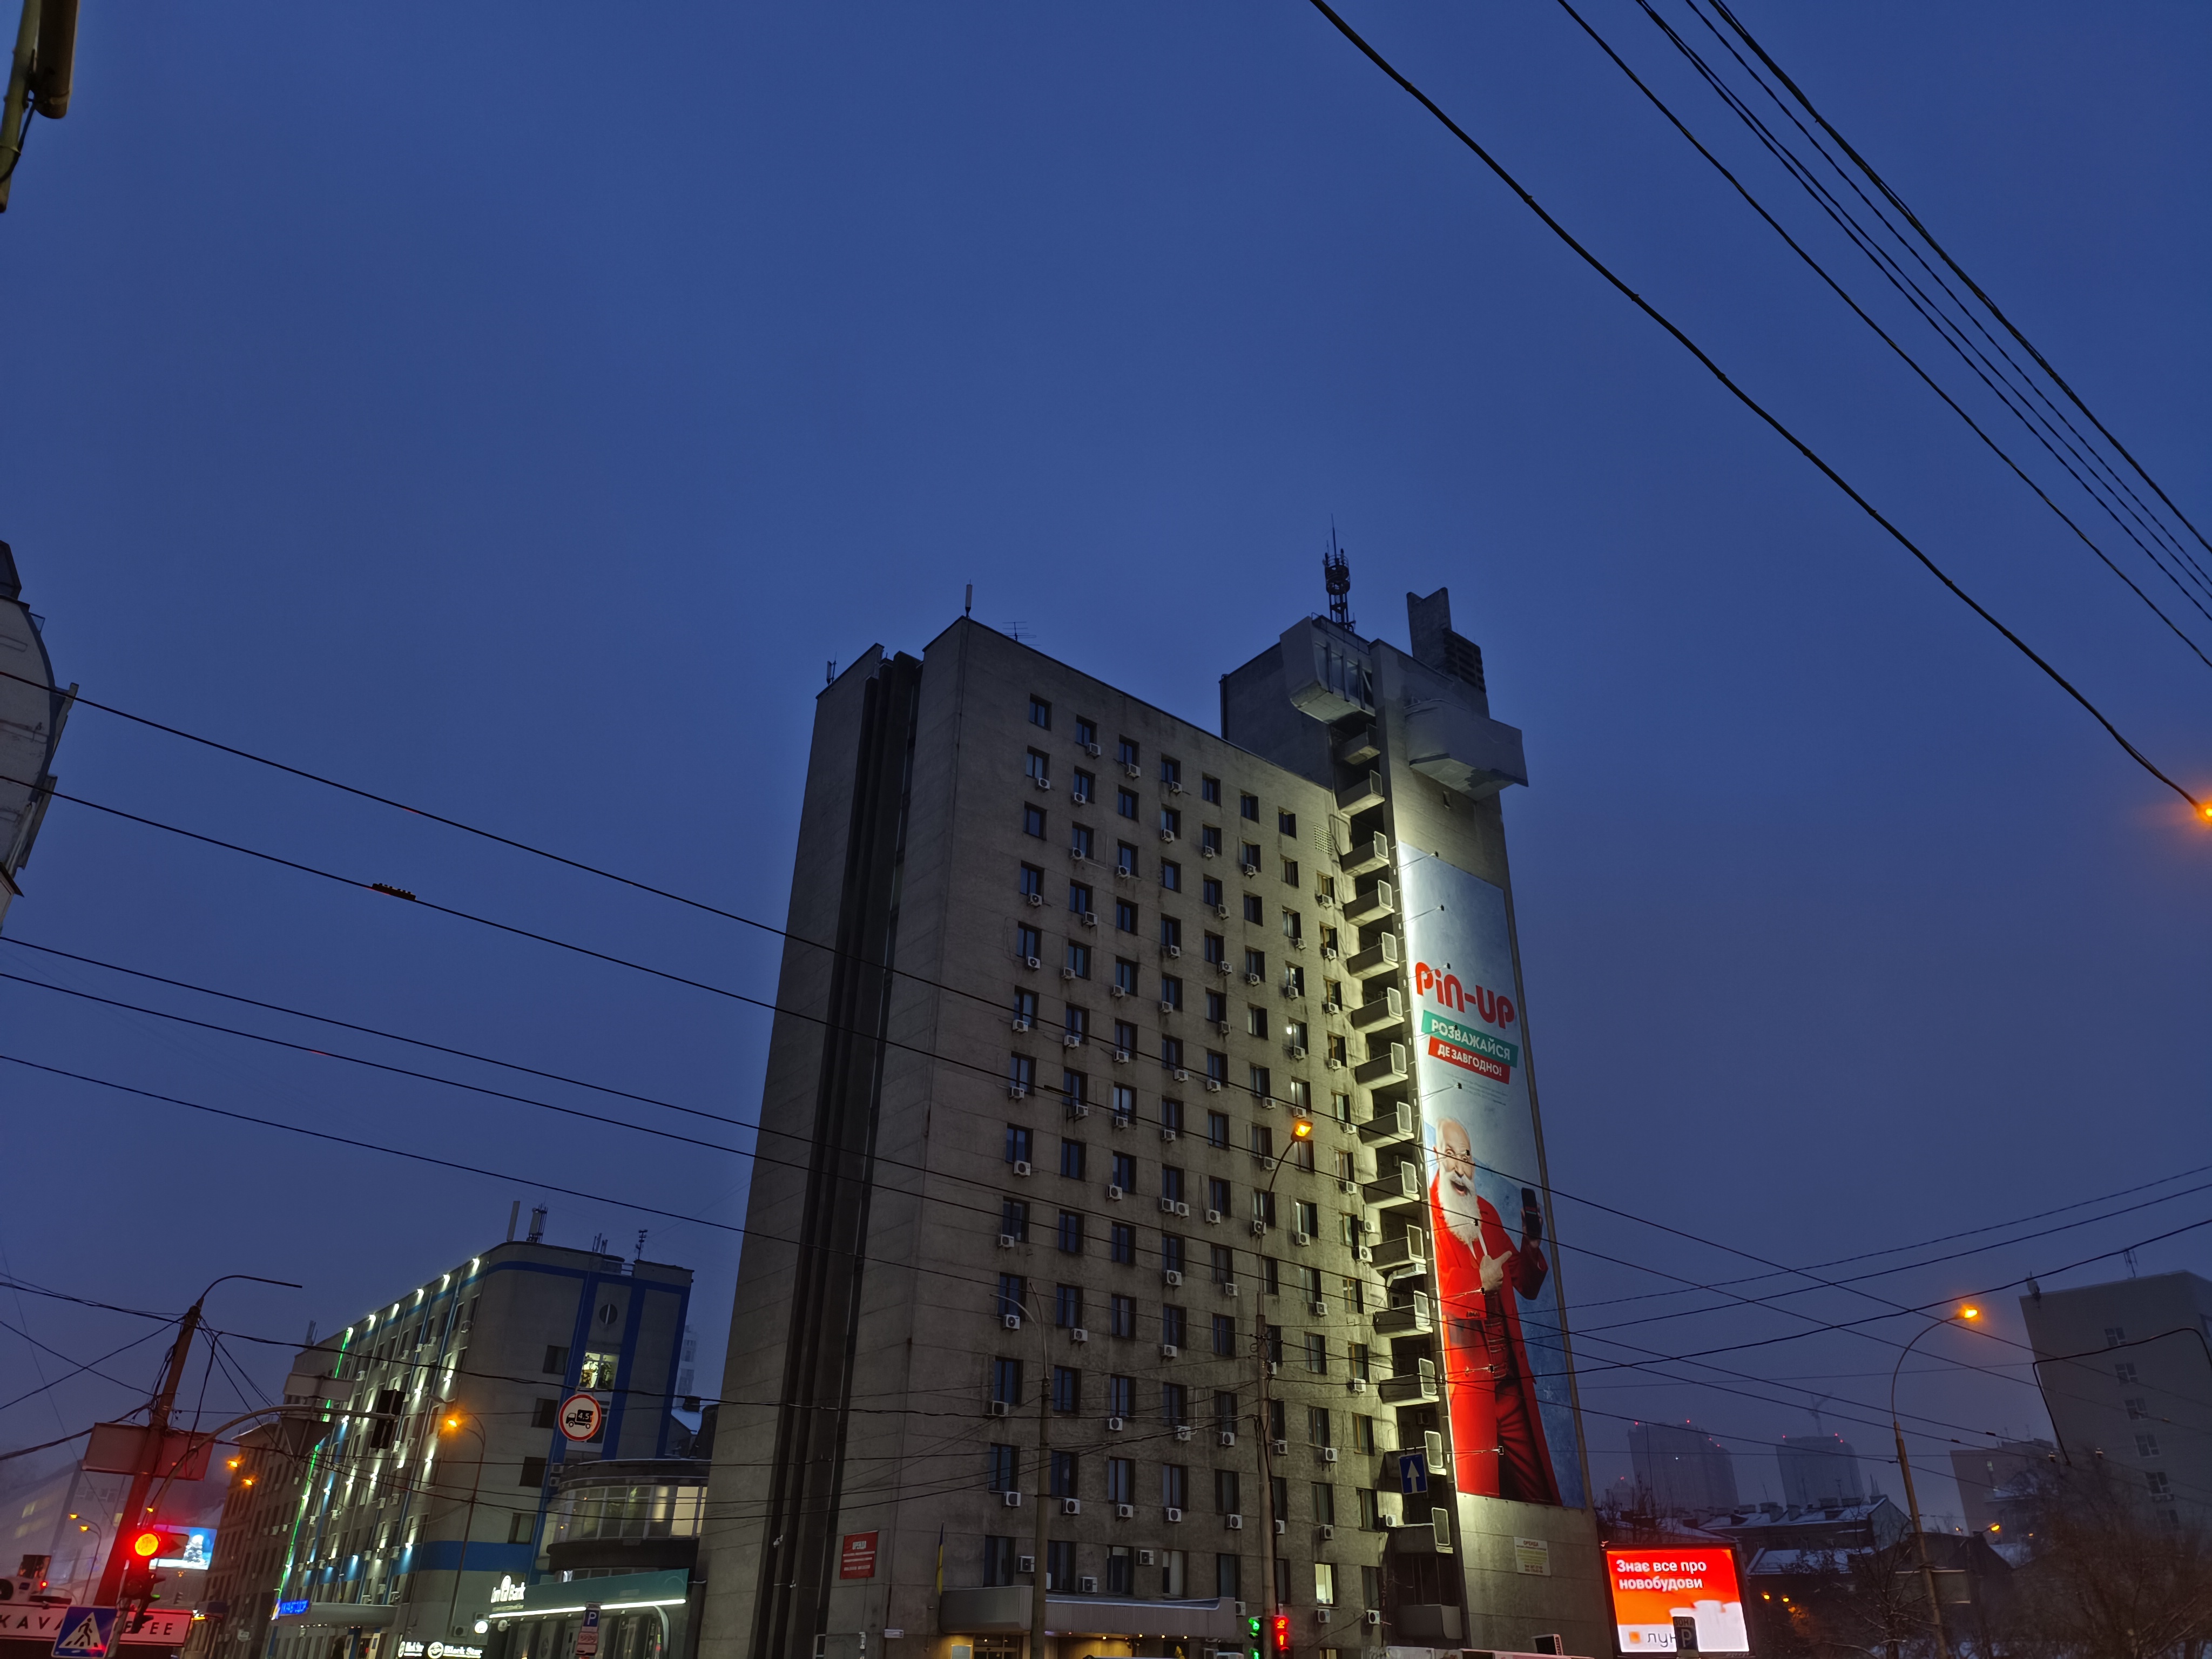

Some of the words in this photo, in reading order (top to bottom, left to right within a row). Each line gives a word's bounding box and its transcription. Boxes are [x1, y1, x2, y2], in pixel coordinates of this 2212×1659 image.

[1431, 1019, 1510, 1061] РОЗВАЖАЙСЯ
[1438, 1043, 1451, 1057] ДЕ
[1451, 1049, 1502, 1076] ЗАВГОДНО!
[1616, 1559, 1650, 1573] Знає
[1653, 1561, 1678, 1572] все
[1681, 1561, 1707, 1574] про
[1619, 1575, 1703, 1592] новобудови
[587, 1611, 597, 1626] P
